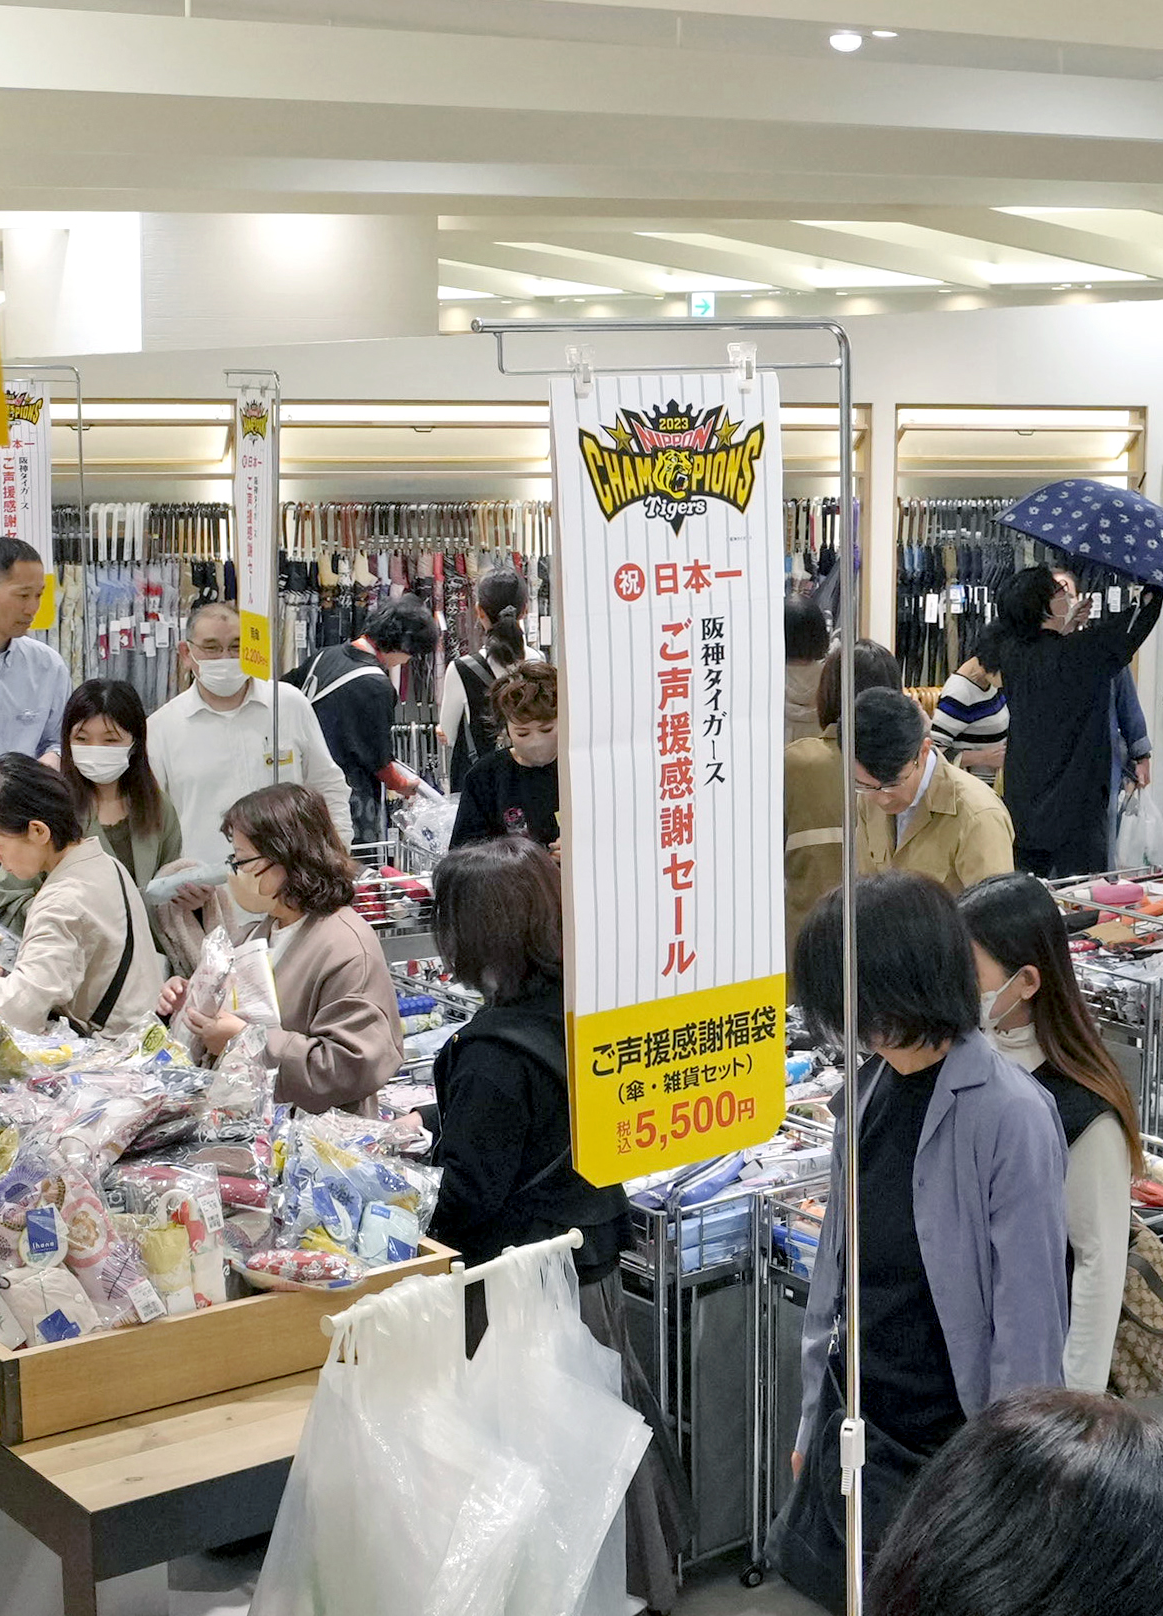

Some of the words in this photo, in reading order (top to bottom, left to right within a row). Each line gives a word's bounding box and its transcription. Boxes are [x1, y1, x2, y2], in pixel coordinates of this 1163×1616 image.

[630, 416, 715, 453] NIPPON
[659, 417, 689, 430] 2023
[3, 457, 17, 538] ご声援感謝セ
[581, 427, 762, 515] CHAMPIONS
[644, 495, 707, 520] Tigers
[614, 563, 646, 602] 祝
[655, 559, 743, 595] 日本一
[700, 616, 726, 786] 阪神タイガース
[656, 618, 697, 977] ご声援感謝セール
[592, 1005, 777, 1077] ご声援感謝福袋
[617, 1053, 754, 1104] （傘・雑貨セット）
[616, 1119, 632, 1156] 税込
[635, 1090, 756, 1150] 5,500円
